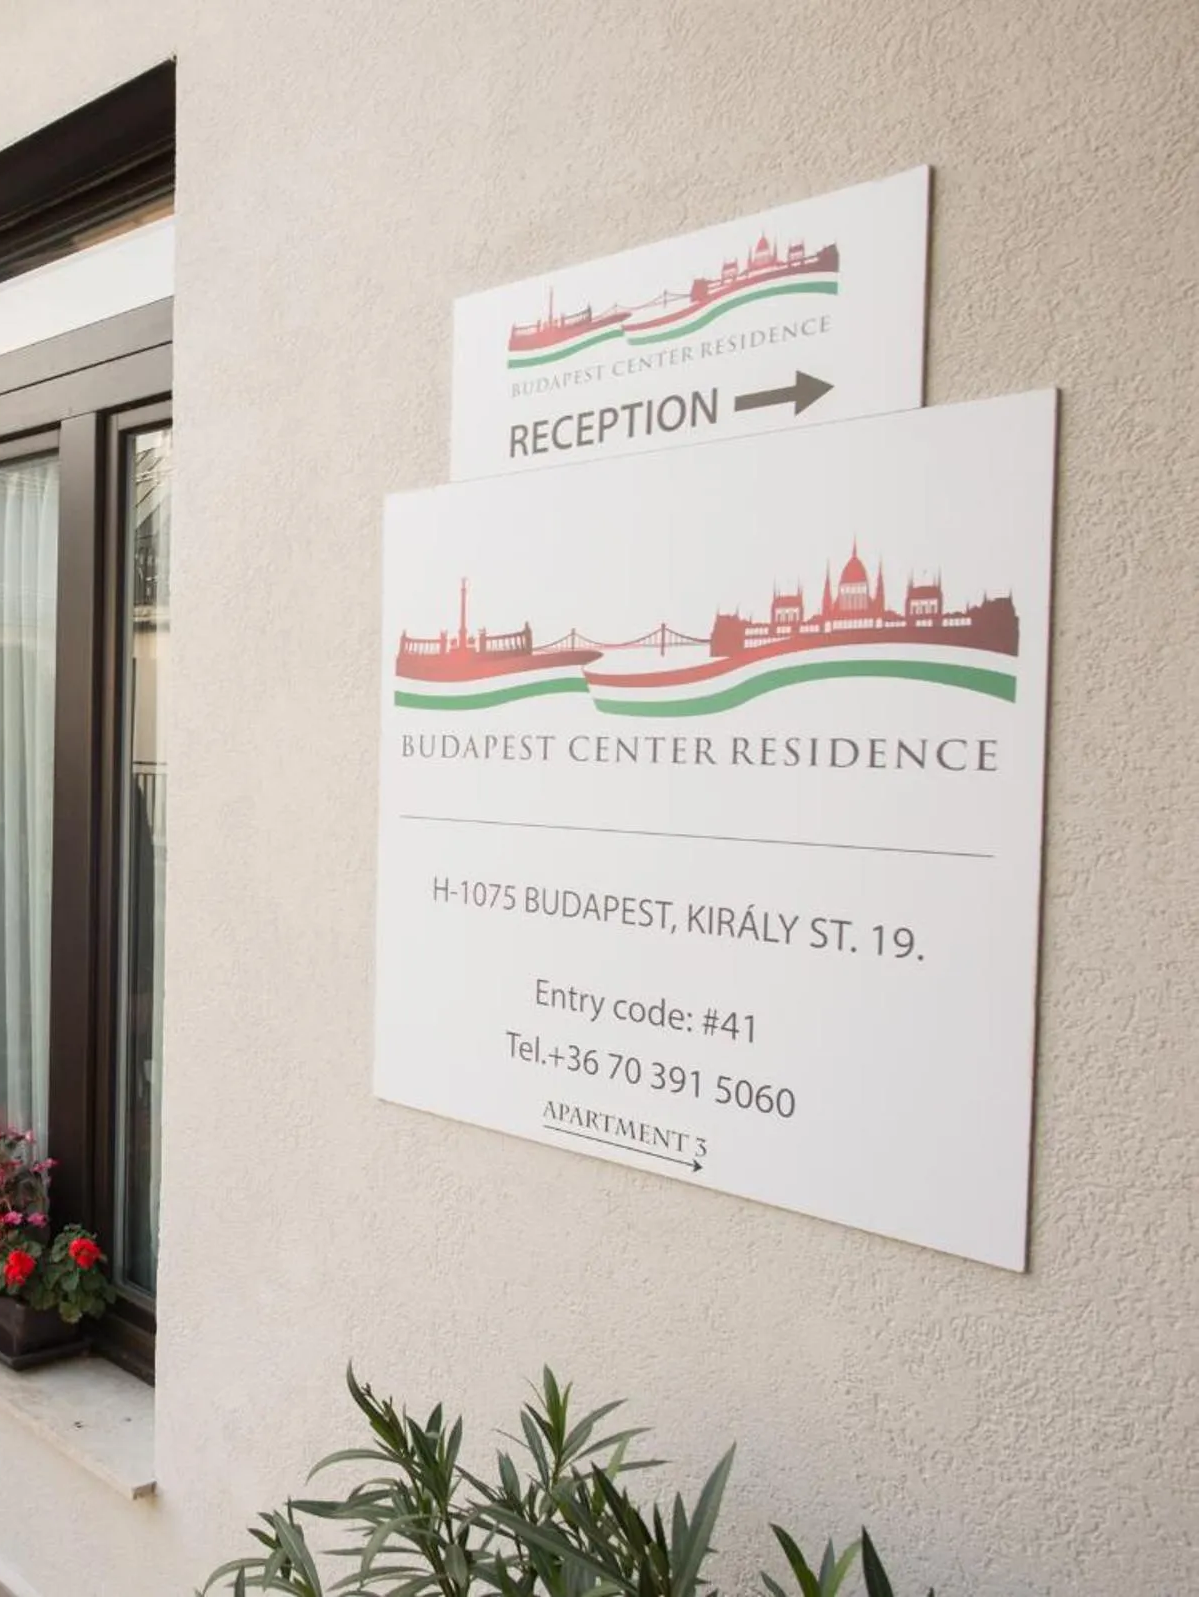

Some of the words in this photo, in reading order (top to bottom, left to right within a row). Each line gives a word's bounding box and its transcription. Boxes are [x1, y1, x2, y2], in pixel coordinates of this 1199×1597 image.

[511, 366, 605, 397] BUDAPEST
[611, 347, 695, 379] CENTER
[700, 315, 833, 359] RESIDENCE
[509, 388, 718, 458] RECEPTION
[401, 735, 557, 763] BUDAPEST
[568, 737, 715, 765] CENTER
[731, 737, 1000, 771] RESIDENCE
[433, 877, 516, 910] H-1075
[525, 889, 678, 935] BUDAPEST,
[687, 904, 797, 946] KIRÁLY
[810, 920, 857, 953] ST.
[871, 926, 925, 961] 19.
[535, 979, 605, 1022] Entry
[613, 999, 693, 1033] code:
[702, 1008, 756, 1043] #41
[506, 1032, 598, 1076] Tel.+36
[608, 1054, 642, 1086] 70
[650, 1063, 702, 1098] 391
[715, 1076, 796, 1118] 5060
[542, 1100, 688, 1152] APARTMENT
[694, 1137, 708, 1156] 3
